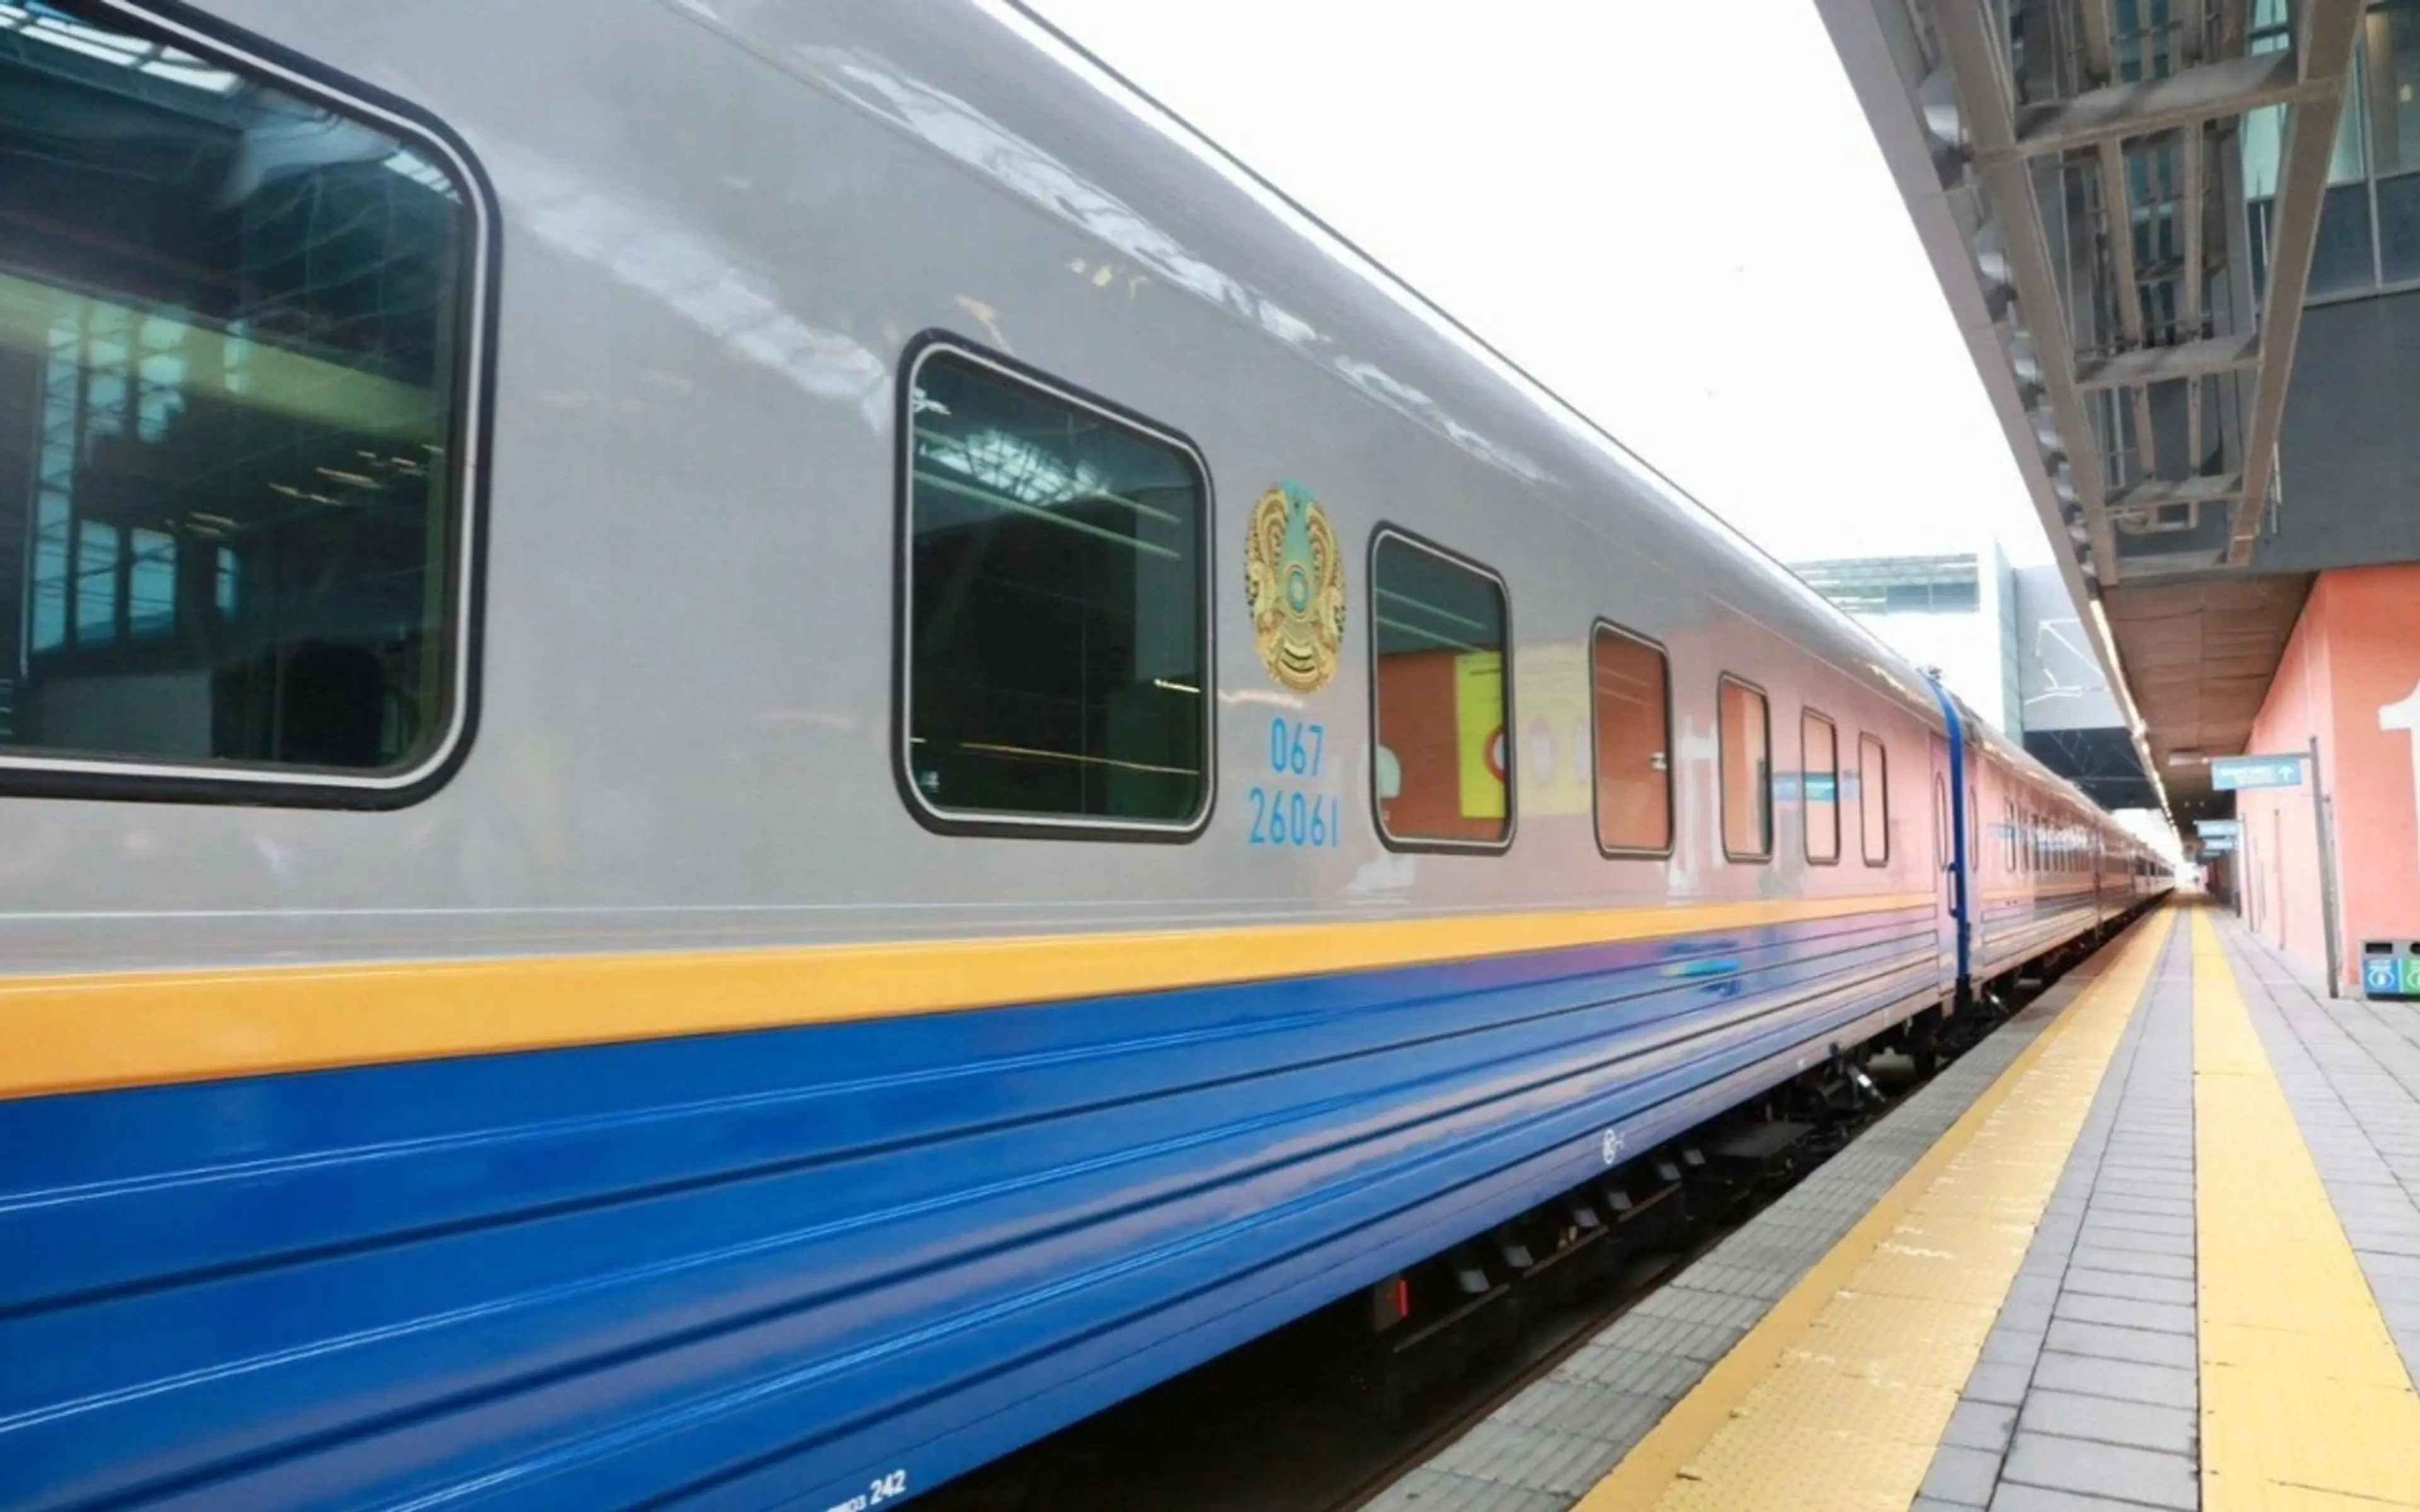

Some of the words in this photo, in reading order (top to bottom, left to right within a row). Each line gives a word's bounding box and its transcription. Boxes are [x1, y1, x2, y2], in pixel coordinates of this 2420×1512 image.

[1271, 717, 1324, 777] 067
[1248, 787, 1339, 848] 26061
[870, 1469, 906, 1505] 242
